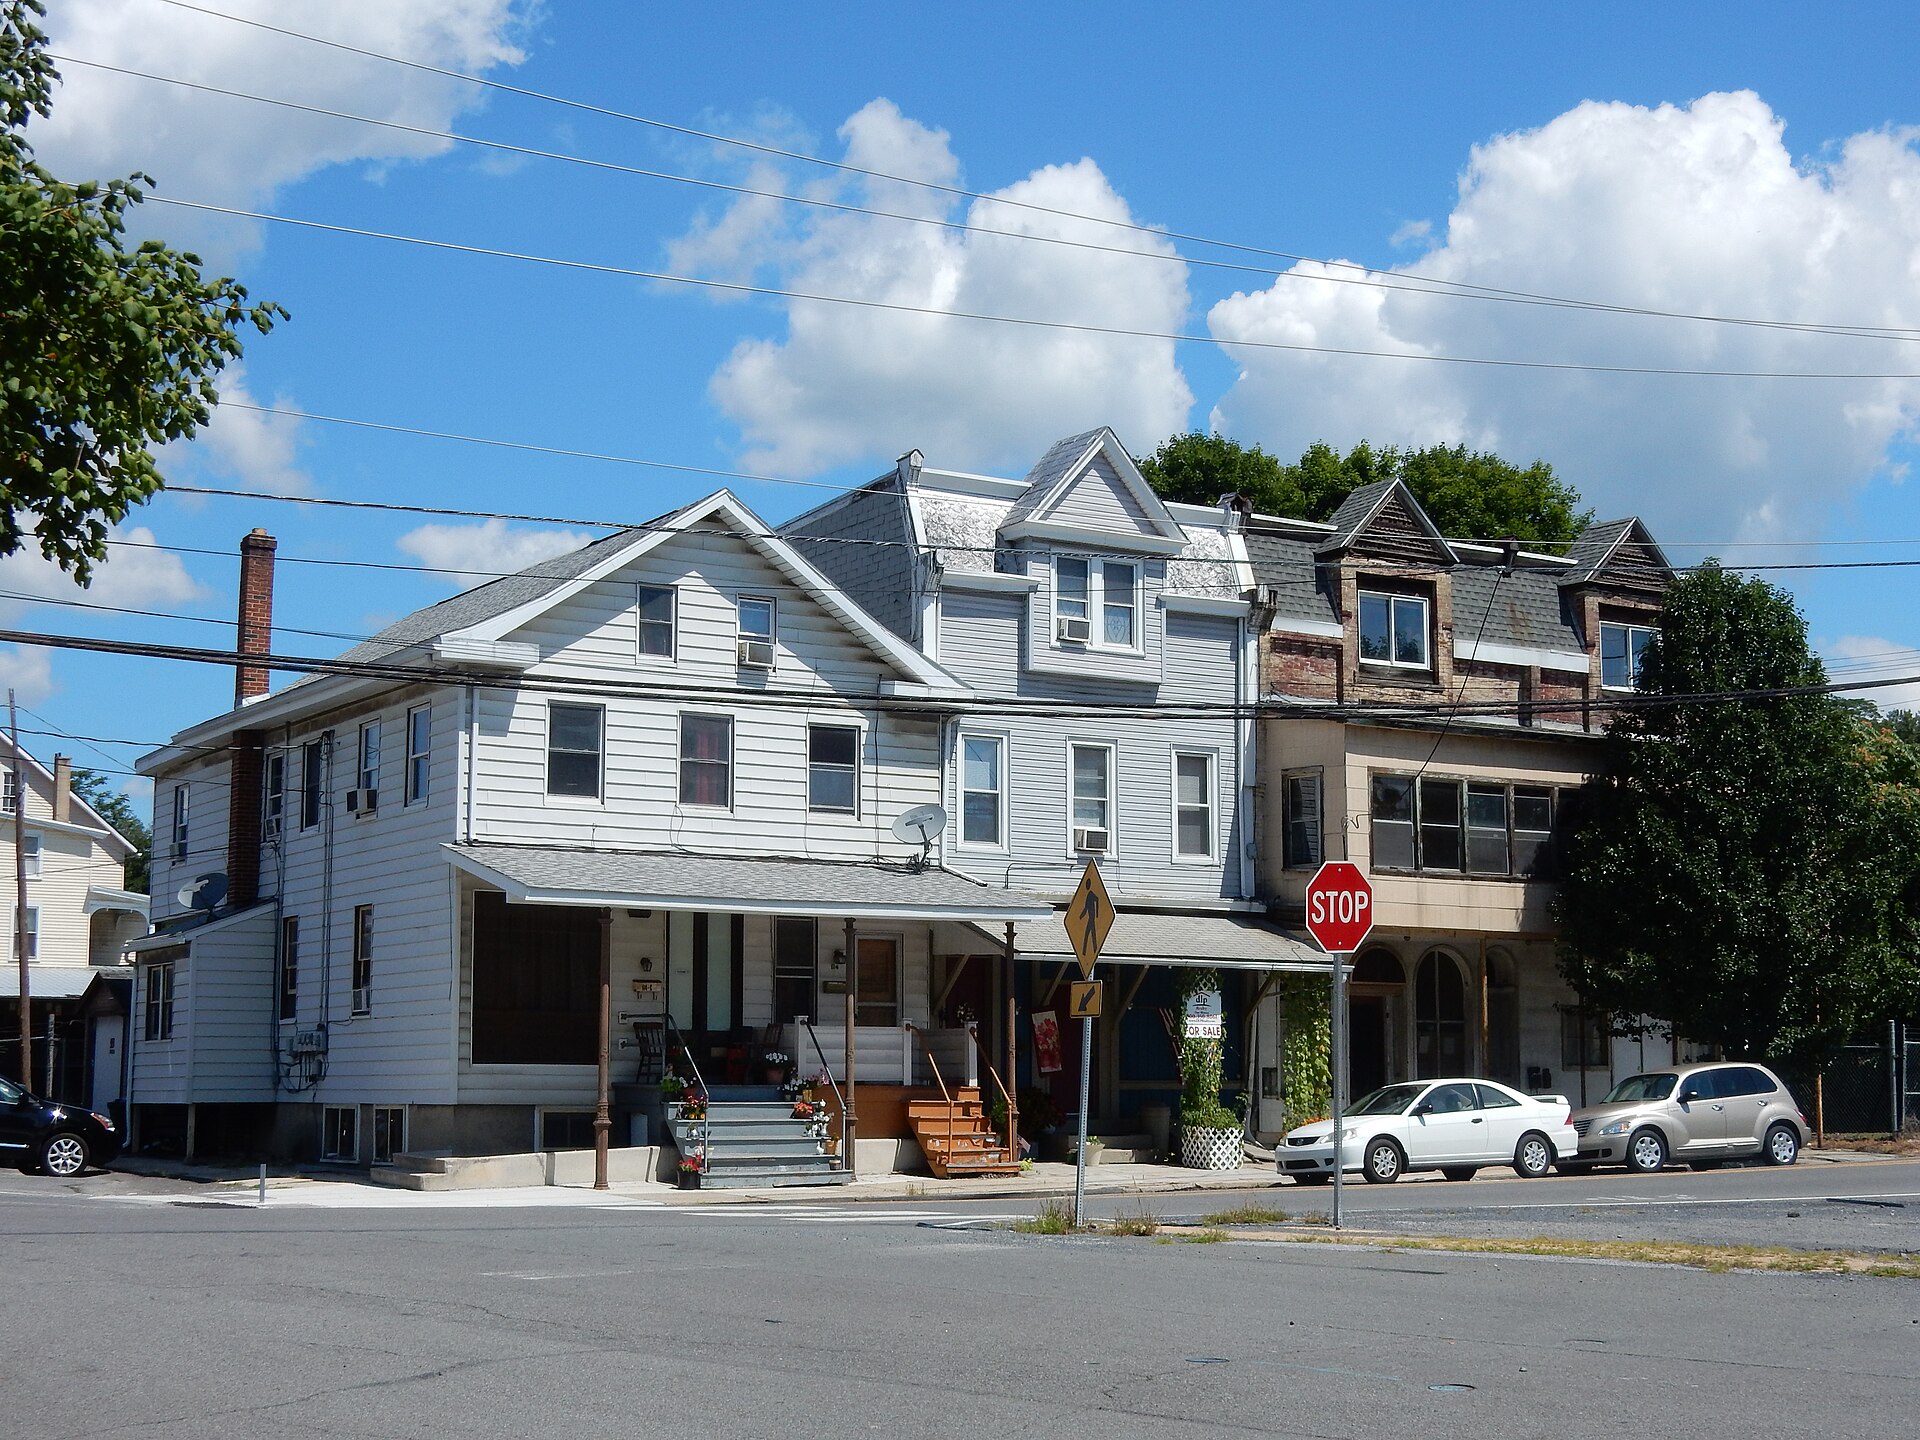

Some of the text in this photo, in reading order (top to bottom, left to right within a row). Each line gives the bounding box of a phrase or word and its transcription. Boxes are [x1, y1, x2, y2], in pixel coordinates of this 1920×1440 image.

[1311, 890, 1369, 923] STOP
[1187, 1026, 1221, 1036] OR SALE
